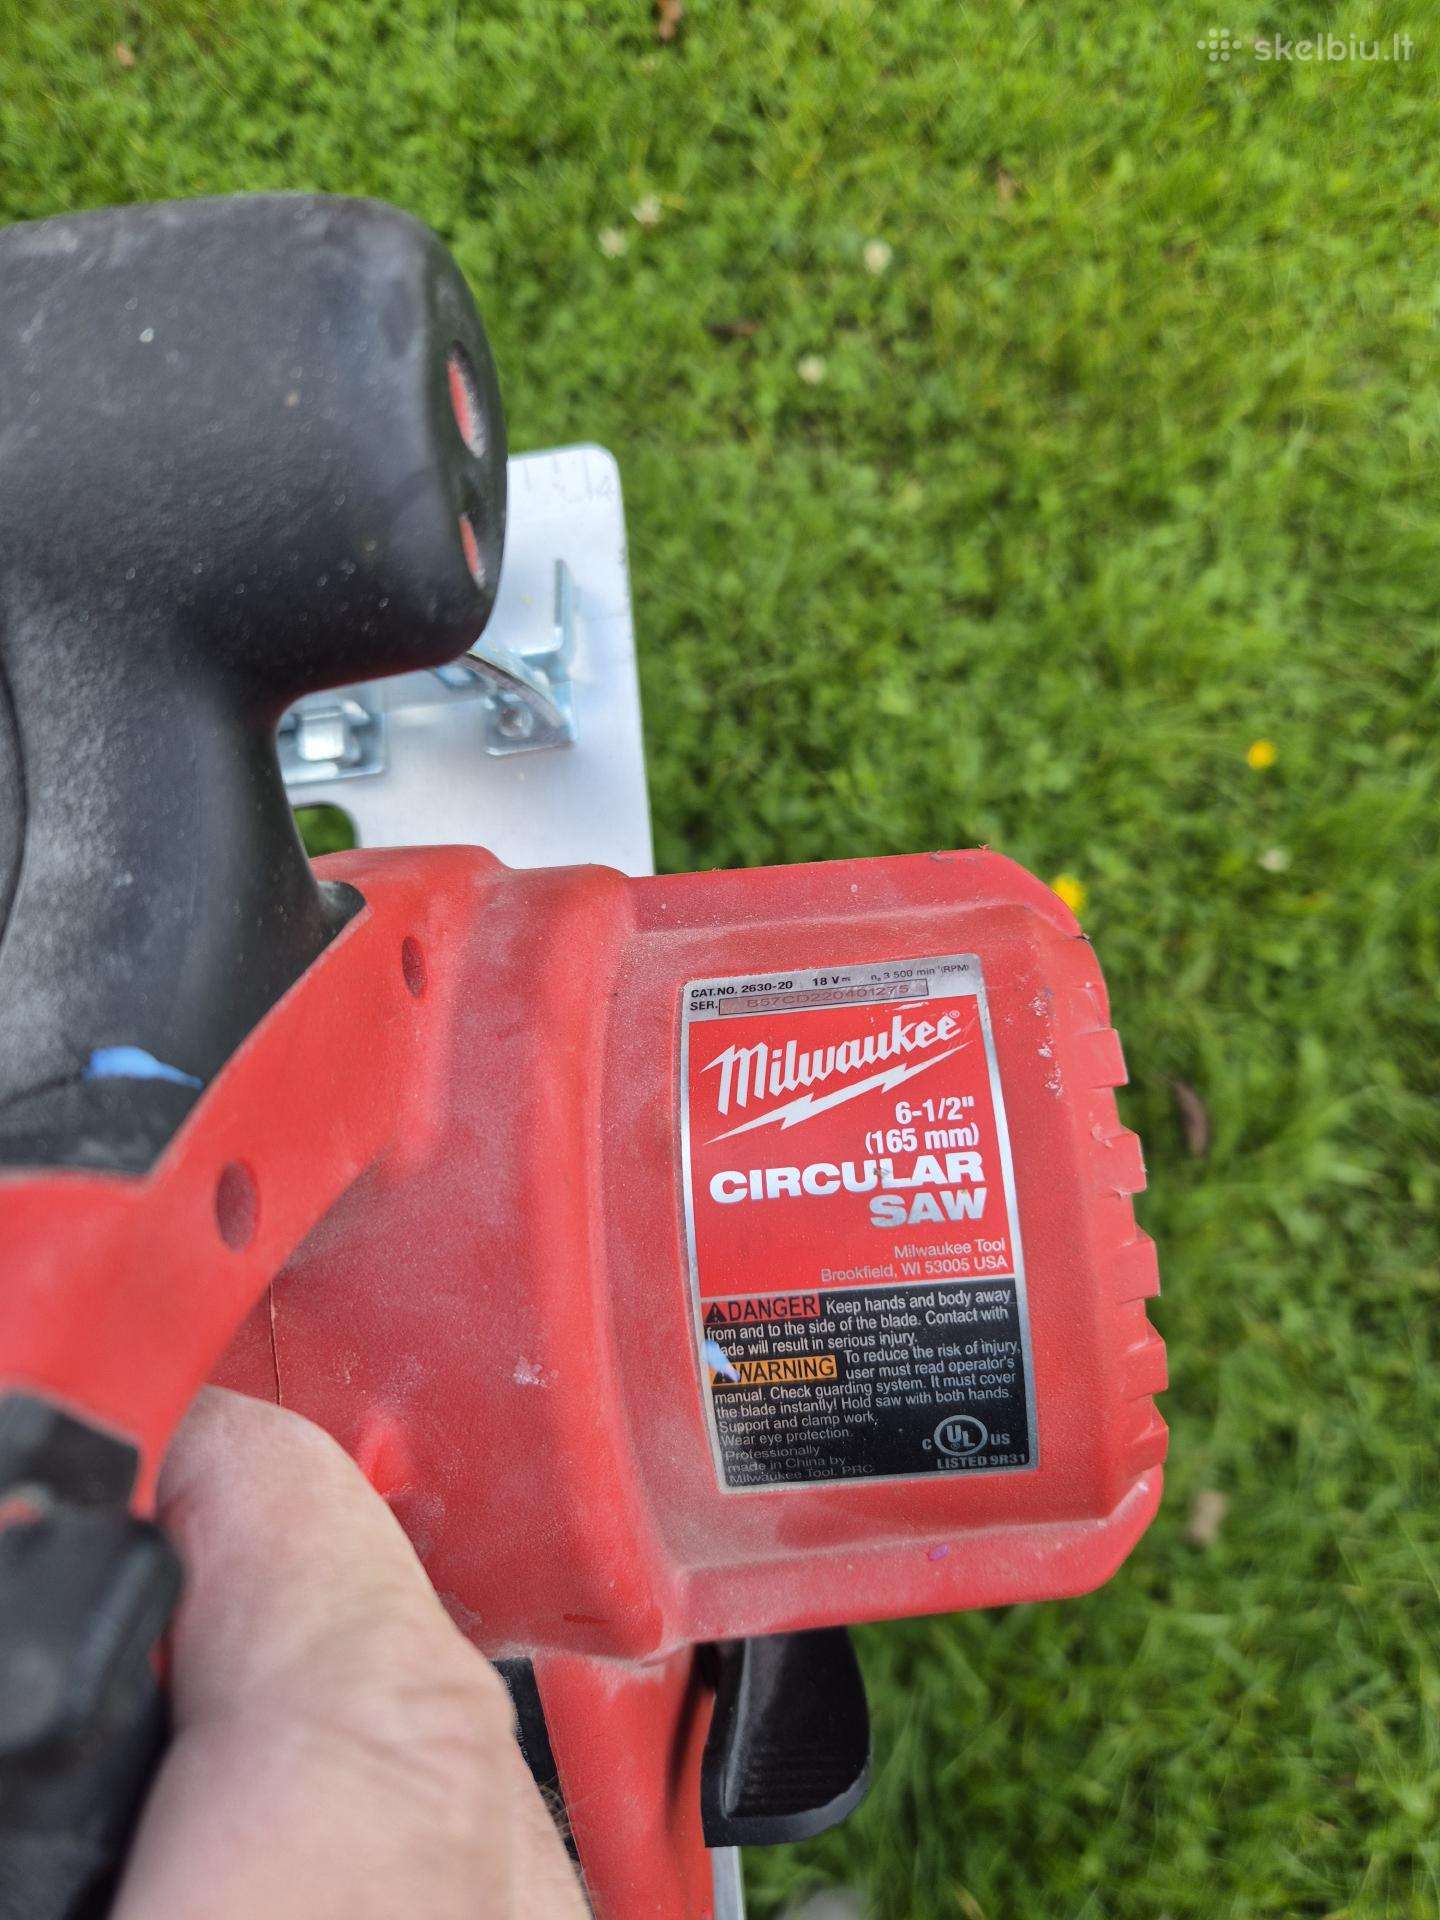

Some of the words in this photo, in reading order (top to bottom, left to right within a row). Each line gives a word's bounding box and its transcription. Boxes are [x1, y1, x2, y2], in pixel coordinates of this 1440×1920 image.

[741, 980, 794, 993] 2630-20
[812, 977, 827, 986] 18
[690, 1001, 718, 1011] SER.
[895, 1096, 974, 1125] 6-1/2"
[865, 1130, 917, 1154] (165
[925, 1122, 980, 1151] mm)
[709, 1151, 985, 1204] CIRCULAR
[869, 1188, 987, 1228] SAW
[894, 1241, 972, 1259] Milwaukee
[974, 1238, 1006, 1253] Tool
[821, 1263, 897, 1282] Brookfield,
[902, 1262, 920, 1276] WI
[925, 1258, 969, 1274] 53005
[974, 1255, 1008, 1271] USA
[728, 1294, 817, 1322] DANGER
[826, 1299, 861, 1315] Keep
[865, 1295, 906, 1312] hands
[910, 1292, 934, 1308] and
[938, 1290, 971, 1307] body
[975, 1289, 1011, 1304] away
[706, 1326, 736, 1341] from
[740, 1324, 764, 1339] and
[768, 1324, 781, 1337] to
[784, 1322, 805, 1335] the
[808, 1319, 835, 1333] side
[840, 1317, 852, 1331] of
[856, 1315, 877, 1330] the
[881, 1313, 922, 1328] blade.
[925, 1308, 978, 1325] Contact
[981, 1305, 1009, 1320] with
[748, 1340, 768, 1355] will
[772, 1337, 809, 1352] result
[811, 1336, 824, 1350] in
[828, 1334, 876, 1348] serious
[879, 1331, 918, 1349] injury.
[731, 1356, 834, 1381] WARNING
[844, 1350, 860, 1364] To
[863, 1348, 909, 1363] reduce
[913, 1345, 934, 1359] the
[937, 1344, 962, 1358] risk
[965, 1341, 978, 1354] of
[845, 1367, 874, 1380] user
[878, 1363, 911, 1377] must
[915, 1361, 944, 1375] read
[948, 1357, 1015, 1375] operator's
[715, 1388, 767, 1404] manual.
[770, 1386, 811, 1400] Check
[815, 1383, 872, 1399] guarding
[876, 1379, 927, 1394] system.
[930, 1375, 940, 1388] It
[943, 1374, 976, 1387] must
[979, 1372, 1016, 1385] cover
[716, 1405, 738, 1419] the
[740, 1403, 776, 1417] blade
[780, 1398, 838, 1415] instantly!
[842, 1396, 871, 1411] Hold
[876, 1394, 901, 1407] saw
[905, 1392, 932, 1406] with
[935, 1389, 965, 1403] both
[968, 1387, 1013, 1401] hands.
[719, 1420, 770, 1434] Support
[773, 1415, 798, 1429] and
[801, 1414, 840, 1428] clamp
[721, 1432, 755, 1447] Wear
[759, 1432, 783, 1446] eye
[725, 1445, 821, 1462] Professionally
[728, 1460, 767, 1473] made
[770, 1458, 782, 1471] in
[785, 1456, 825, 1469] China
[829, 1455, 846, 1468] by
[937, 1455, 988, 1470] LISTED
